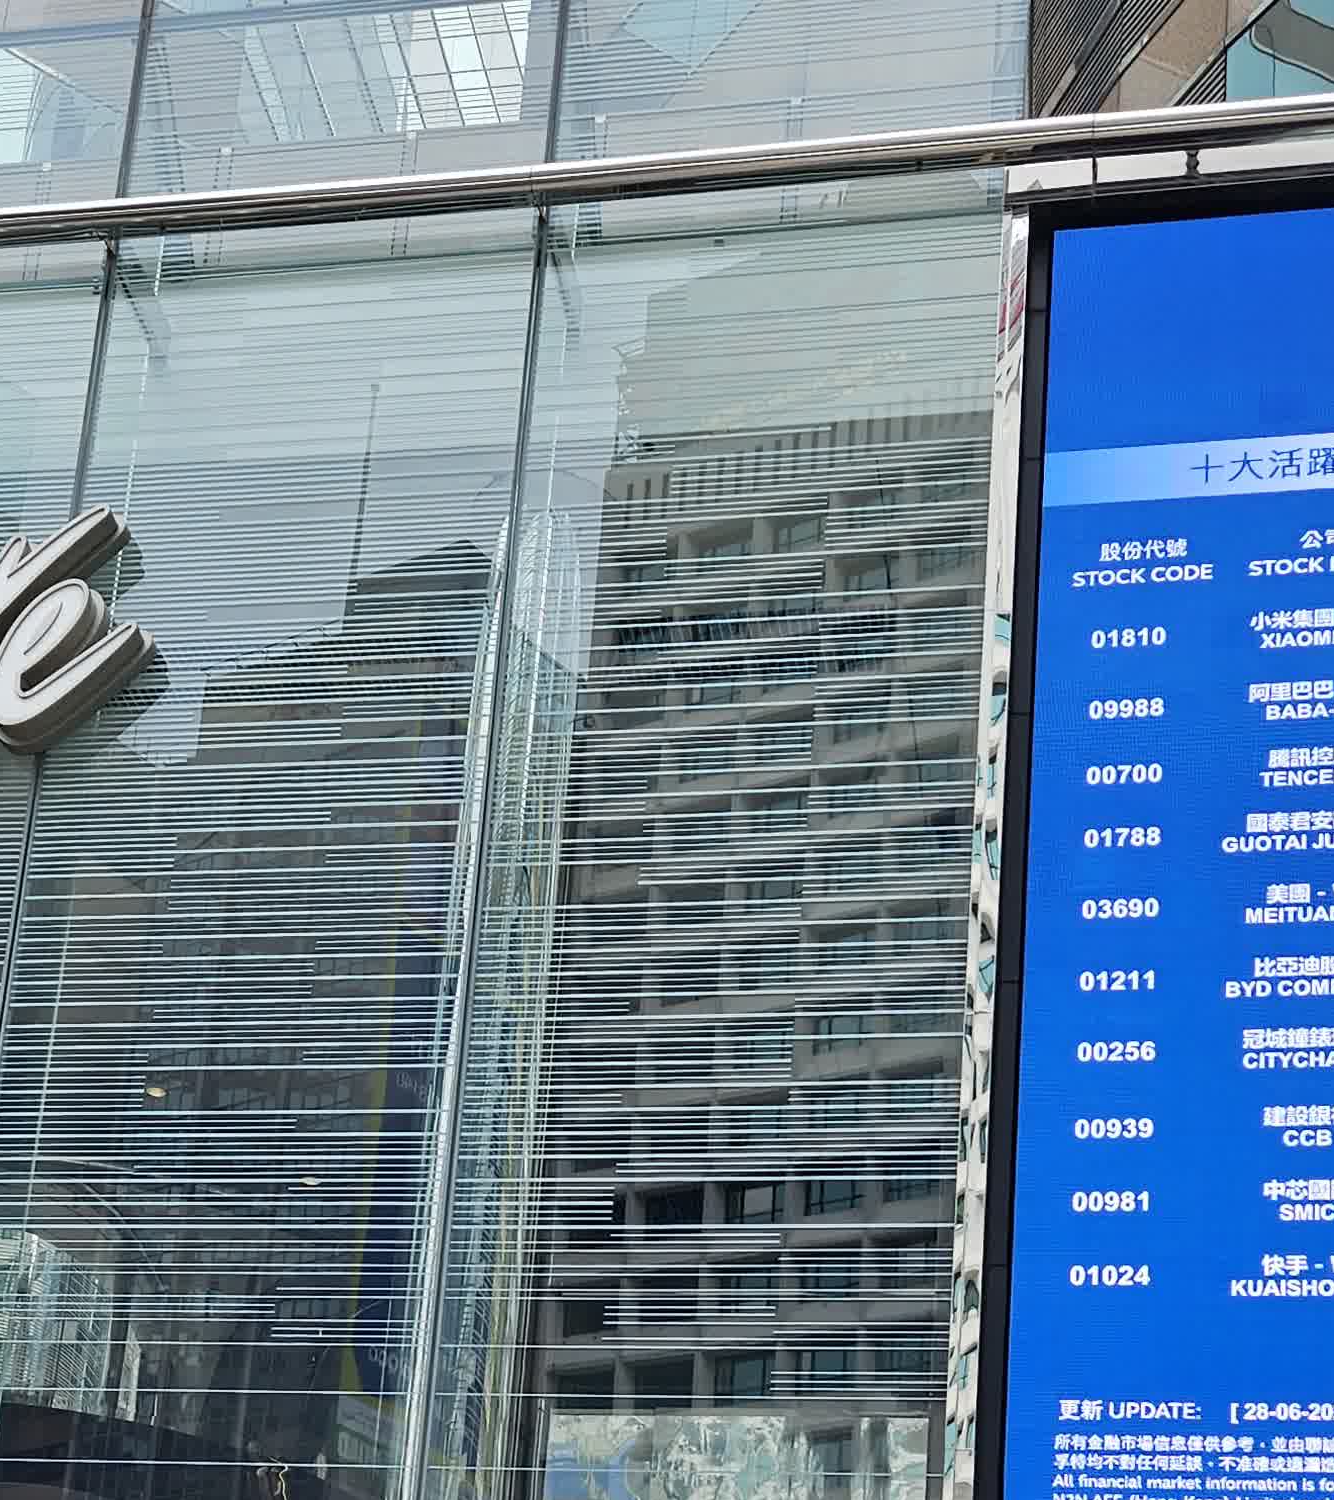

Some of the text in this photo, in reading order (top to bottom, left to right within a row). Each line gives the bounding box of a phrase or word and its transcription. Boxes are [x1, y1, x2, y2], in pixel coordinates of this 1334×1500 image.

[1099, 539, 1187, 561] 股份代號
[1073, 564, 1213, 587] STOCK CODE
[1249, 557, 1324, 576] STOCK
[1091, 627, 1166, 648] 01810
[1089, 698, 1164, 719] 09988
[1087, 763, 1162, 784] 00700
[1084, 827, 1161, 848] 01788
[1222, 831, 1307, 852] GUOTAI
[1082, 898, 1159, 919] 03690
[1080, 971, 1154, 991] 01211
[1226, 981, 1271, 998] BYD
[1078, 1041, 1155, 1061] 00256
[1075, 1118, 1153, 1138] 00939
[1283, 1130, 1332, 1146] CCB
[1072, 1191, 1148, 1212] 00981
[1070, 1265, 1150, 1286] 01024
[1059, 1400, 1103, 1420] 更新
[1109, 1402, 1201, 1419] UPDATE:
[1052, 1474, 1074, 1487] All
[1078, 1474, 1142, 1489] financial
[1147, 1476, 1201, 1489] market
[1206, 1477, 1297, 1491] information
[1302, 1478, 1315, 1491] is
